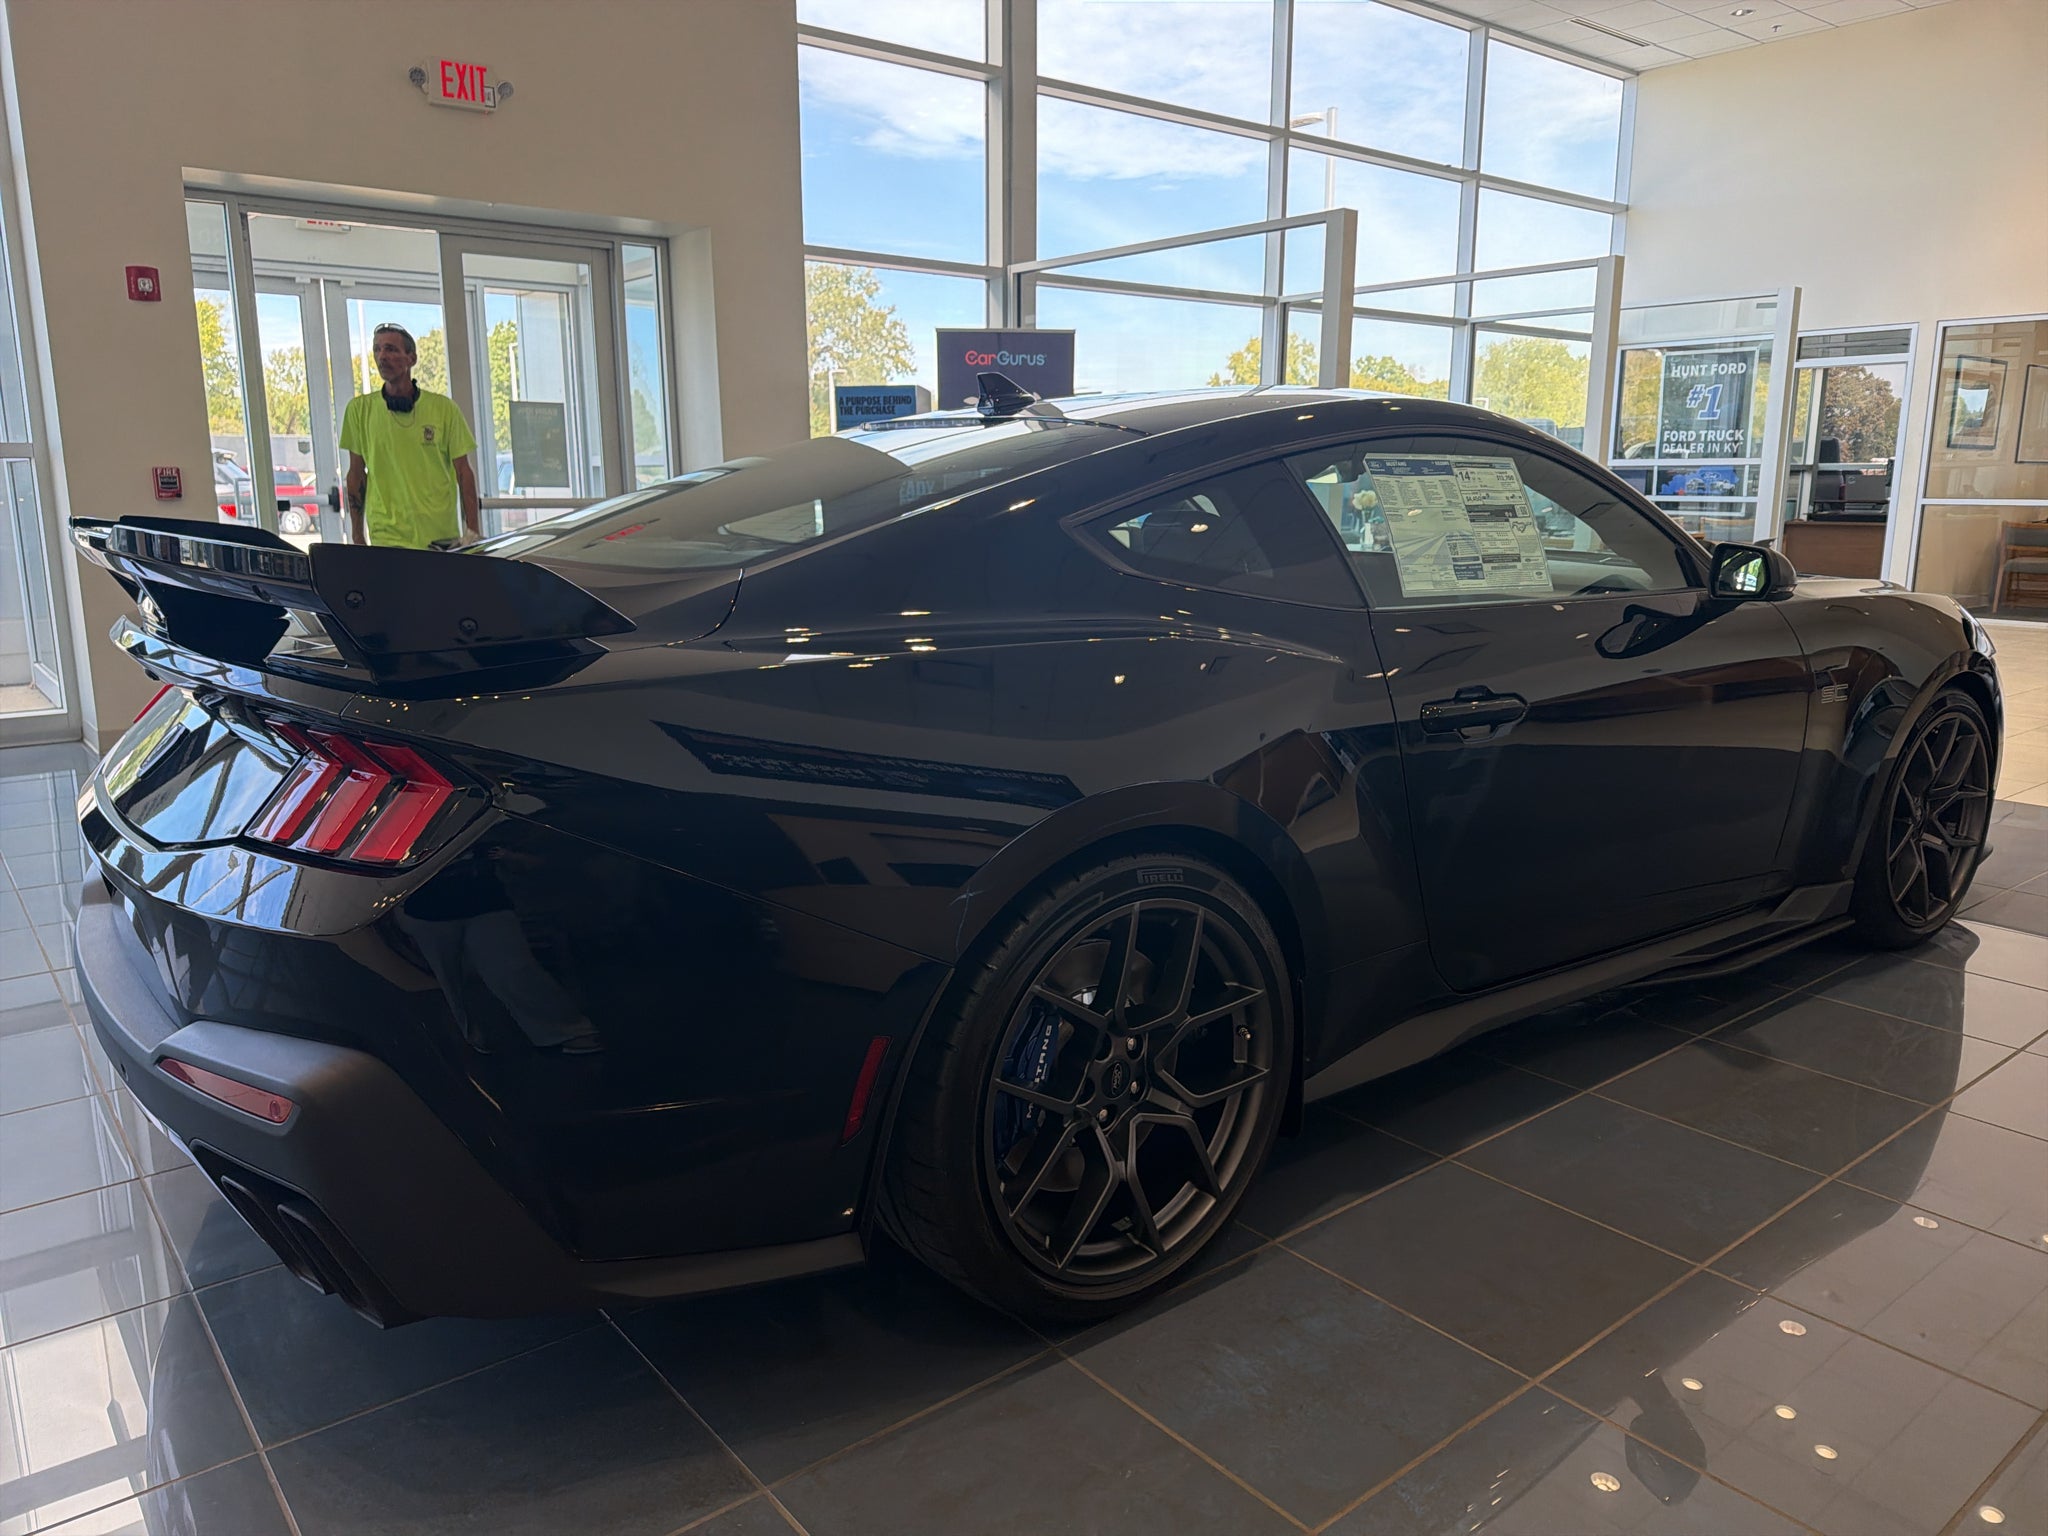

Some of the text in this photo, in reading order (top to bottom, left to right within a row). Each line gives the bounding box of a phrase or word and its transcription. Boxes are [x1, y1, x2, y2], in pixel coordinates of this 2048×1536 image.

[440, 59, 487, 103] EXIT
[965, 350, 1046, 366] CarGurus
[1671, 362, 1747, 378] HUNT FORD
[839, 395, 912, 407] A PURPOSE BEHIND
[1686, 383, 1723, 420] #1
[840, 405, 896, 416] THE PURCHASE
[1663, 429, 1745, 442] FORD TRUCK
[1662, 442, 1705, 454] DEALER
[1707, 442, 1723, 453] IN
[1459, 471, 1471, 481] 14
[1137, 867, 1184, 885] PIRELLI
